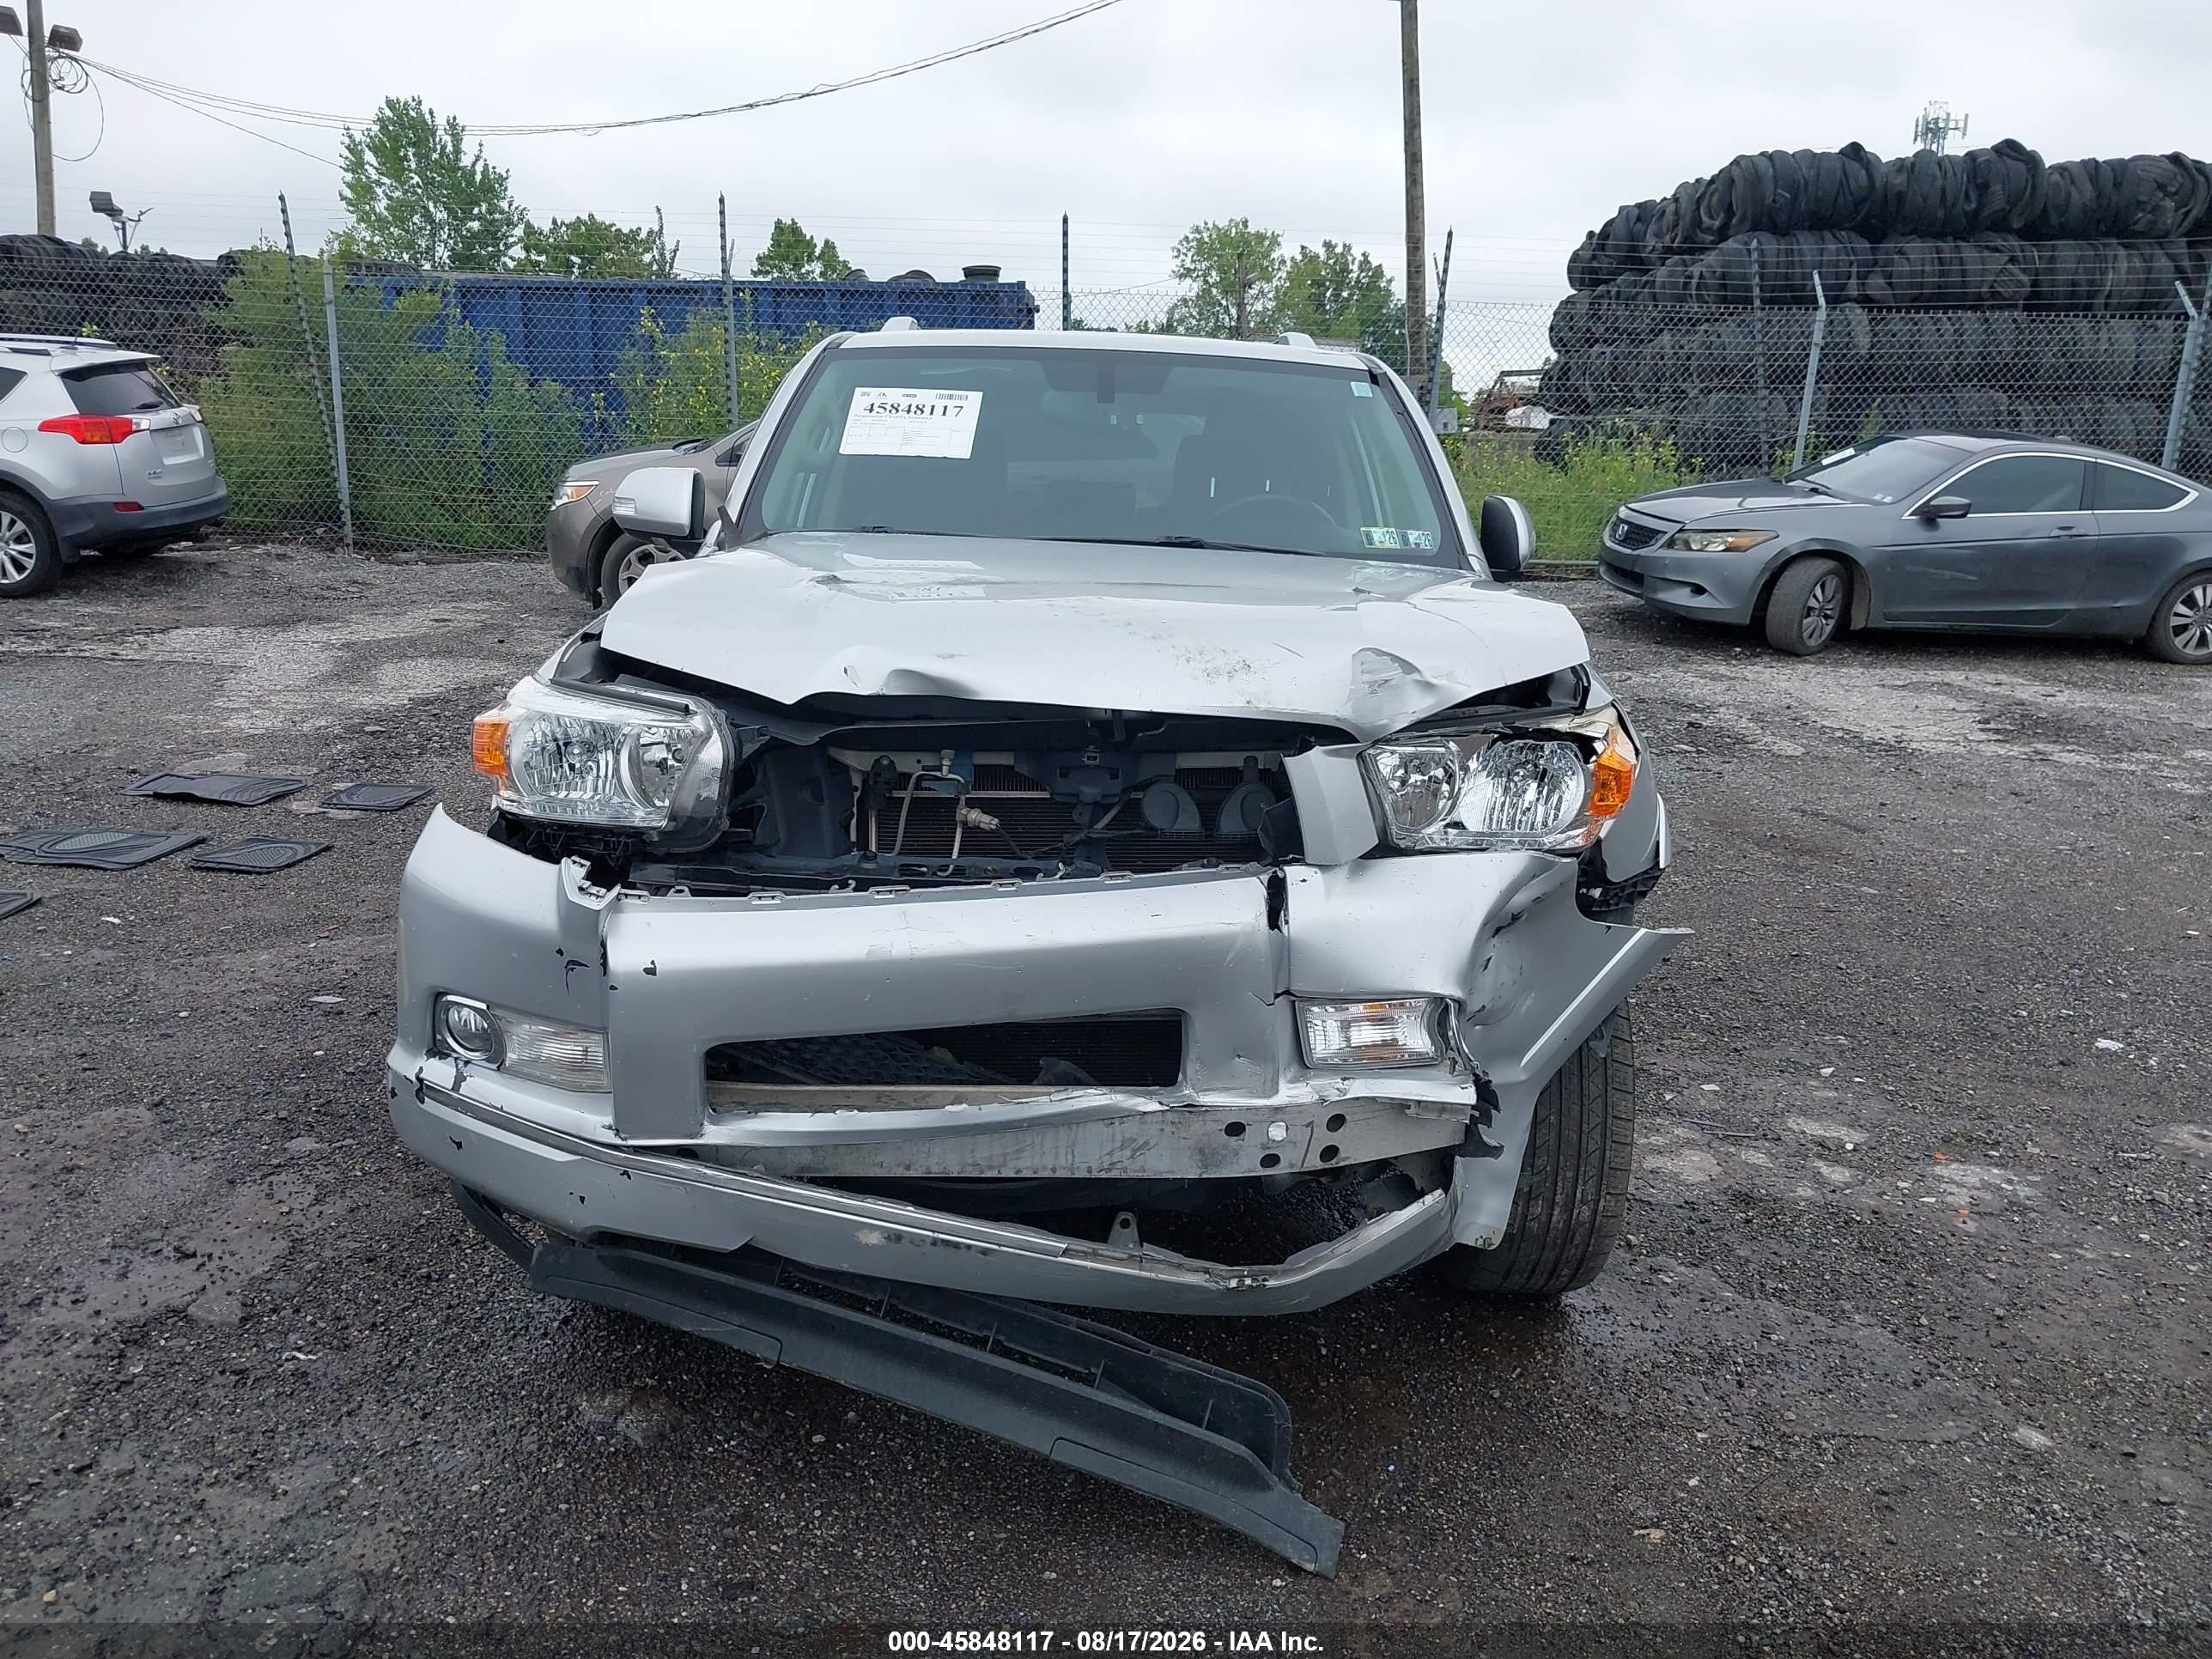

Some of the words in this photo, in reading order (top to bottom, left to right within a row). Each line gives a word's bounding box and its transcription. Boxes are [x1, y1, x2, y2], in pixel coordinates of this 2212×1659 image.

[863, 402, 964, 417] 45848117
[1386, 530, 1397, 544] 26
[1422, 532, 1433, 547] 26
